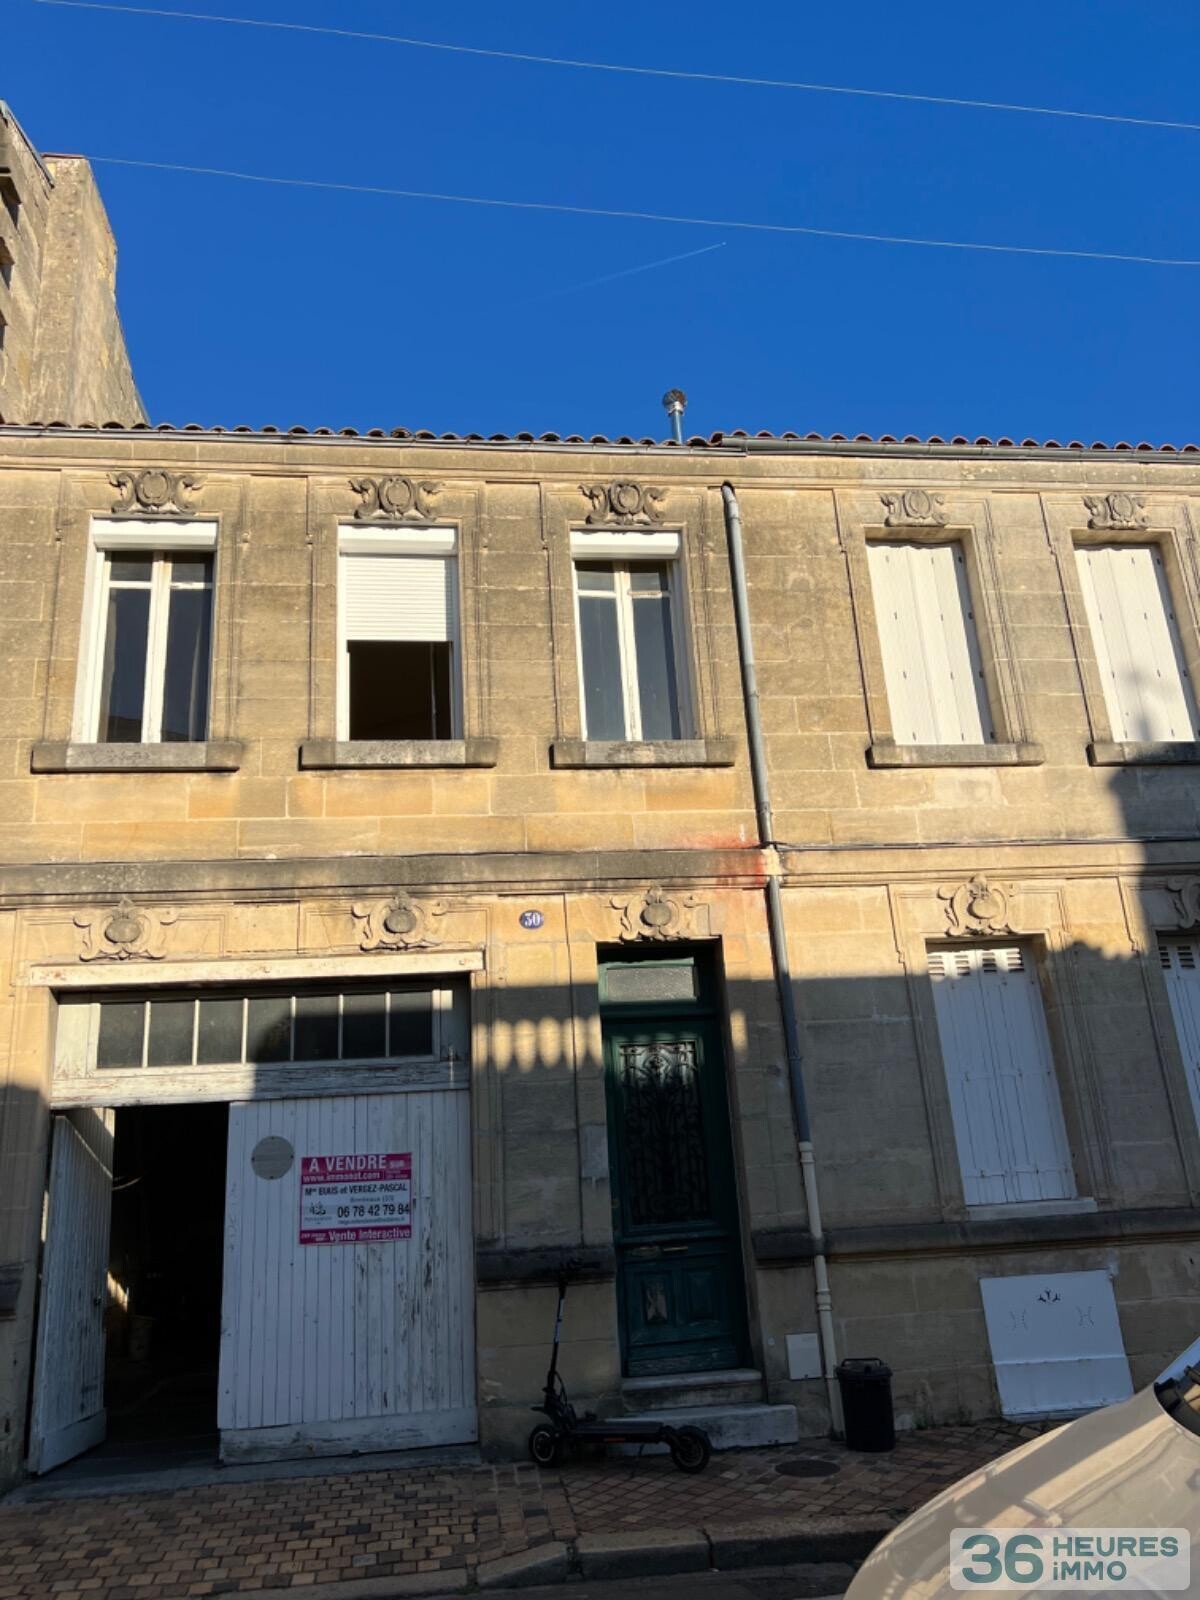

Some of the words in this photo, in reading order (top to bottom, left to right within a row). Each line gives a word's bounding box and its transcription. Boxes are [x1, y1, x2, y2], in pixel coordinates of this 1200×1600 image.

[309, 1158, 319, 1173] A
[325, 1154, 387, 1171] VENDRE
[337, 1206, 350, 1218] 06
[368, 1205, 380, 1216] 42
[382, 1204, 396, 1216] 79
[328, 1230, 357, 1241] Vente
